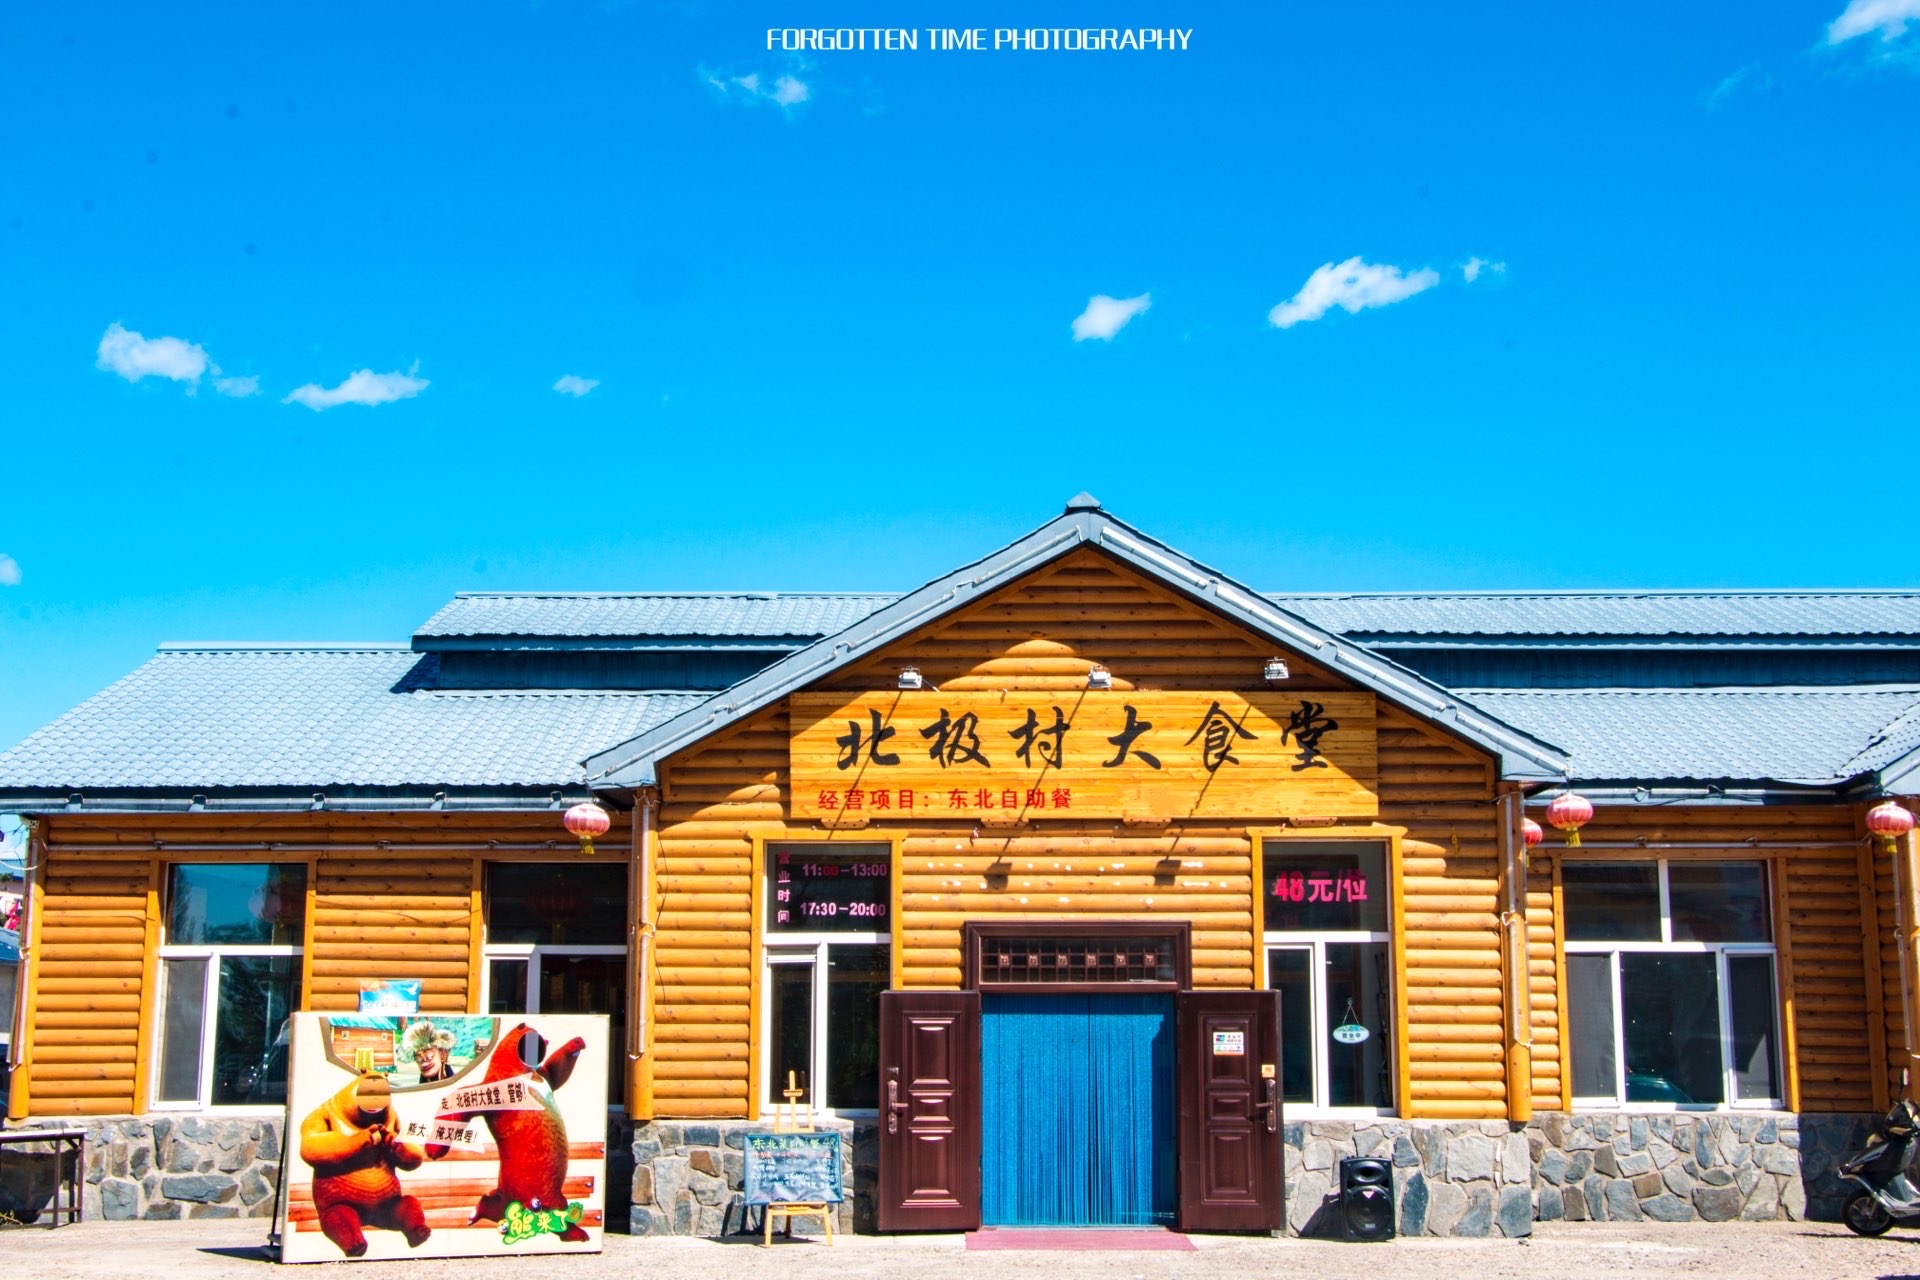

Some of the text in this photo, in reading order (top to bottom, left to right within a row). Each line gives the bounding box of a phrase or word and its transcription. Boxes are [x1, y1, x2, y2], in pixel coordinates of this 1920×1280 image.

[835, 700, 1339, 773] 北极村大食堂
[777, 850, 791, 923] 营业时间
